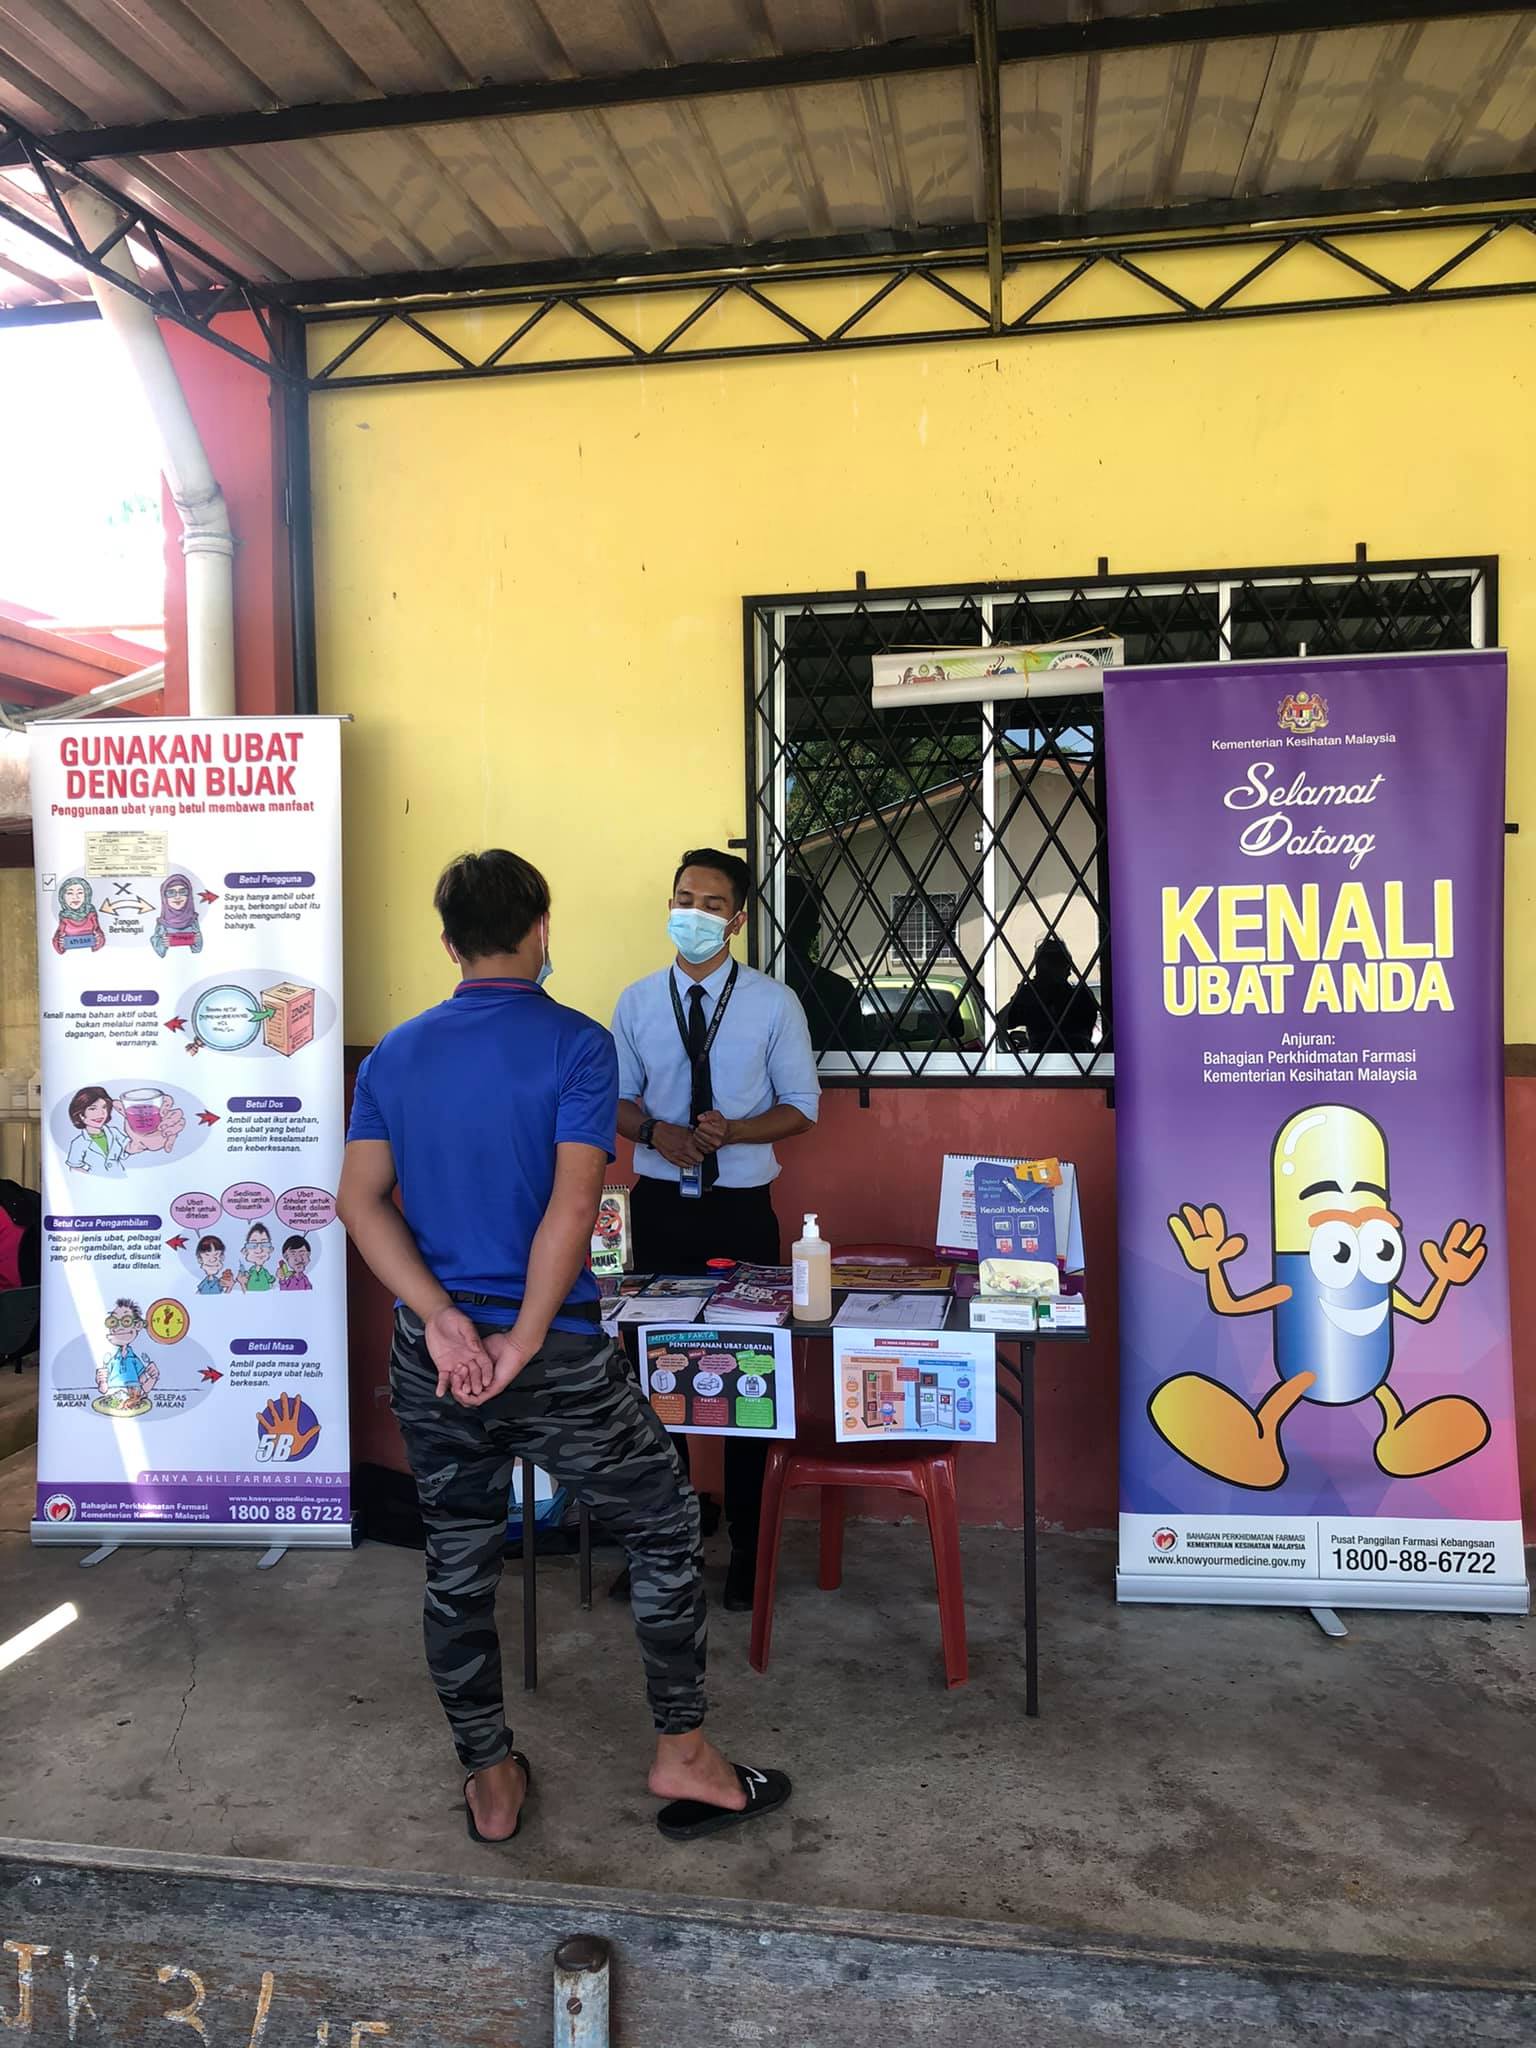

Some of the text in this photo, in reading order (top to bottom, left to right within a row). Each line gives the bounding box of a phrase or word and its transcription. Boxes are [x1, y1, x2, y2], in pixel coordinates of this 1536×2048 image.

[1212, 733, 1396, 750] Kementerian Kesihatan Malaysia
[60, 732, 304, 767] GUNAKAN UBAT
[66, 766, 296, 799] DENGAN BIJAK
[1223, 761, 1386, 810] Selamat
[51, 800, 315, 818] Penggunaan ubat yang betul membawa manfaat
[1239, 811, 1376, 870] Datang
[239, 874, 302, 885] Betul Pengguna
[224, 892, 315, 902] Saya hanya ambil ubat
[224, 902, 321, 912] saya, berkongsi ubat itu
[224, 911, 301, 921] boleh mengundang
[113, 918, 140, 927] Jangan
[224, 922, 256, 931] bahaya.
[1161, 879, 1454, 964] KENALI
[109, 925, 144, 935] Berkongsi
[1162, 961, 1455, 1016] UBAT ANDA
[97, 993, 143, 1002] Betul Ubat
[102, 1020, 134, 1028] melalui
[65, 1031, 107, 1039] dagangan,
[1281, 1032, 1336, 1048] Anjuran:
[1204, 1049, 1416, 1067] Bahagian Perkhidmatan Farmasi
[1204, 1067, 1417, 1084] Kementerian Kesihatan Malaysia
[245, 1100, 284, 1108] Betul Dos
[226, 1116, 252, 1124] Ambil
[289, 1116, 319, 1124] arahan,
[265, 1126, 285, 1135] yang
[226, 1135, 319, 1144] menjamin keselamatan
[980, 1205, 1049, 1214] Kenali Ubat Anda
[53, 1219, 148, 1229] Betul Cara Pengambilan
[48, 1233, 161, 1243] Pelbagai jenis ubat, pelbagai
[144, 1243, 161, 1251] ubat
[70, 1253, 92, 1262] perlu
[94, 1253, 127, 1261] disedut,
[248, 1342, 294, 1351] Betul Masa
[230, 1360, 254, 1368] Ambil
[255, 1360, 276, 1369] pada
[301, 1361, 321, 1370] yang
[230, 1369, 251, 1377] betul
[253, 1370, 282, 1378] supaya
[304, 1370, 324, 1378] lebih
[230, 1379, 270, 1387] berkesan.
[156, 1401, 185, 1409] MAKAN
[255, 1433, 294, 1462] 5B
[144, 1474, 343, 1484] TANYA AHLI FARMASI ANDA
[229, 1496, 342, 1504] www.knowyourmedicine.gov.my
[81, 1502, 117, 1510] Bahagian
[177, 1503, 208, 1511] Farmasi
[81, 1511, 210, 1520] Kementerian Malaysia
[229, 1505, 343, 1521] 1800 88 6722
[1186, 1532, 1306, 1542] BAHAGIAN PERKHIDMATAN FARMASI
[1331, 1535, 1495, 1549] Pusat Panggilan Farmasi Kebangsaan
[1186, 1541, 1306, 1550] KEMENTERIAN KESIHATAN MALAYSIA
[1148, 1555, 1306, 1569] www.knowyourmedicine.gov.my
[1332, 1548, 1496, 1574] 1800-88-6722
